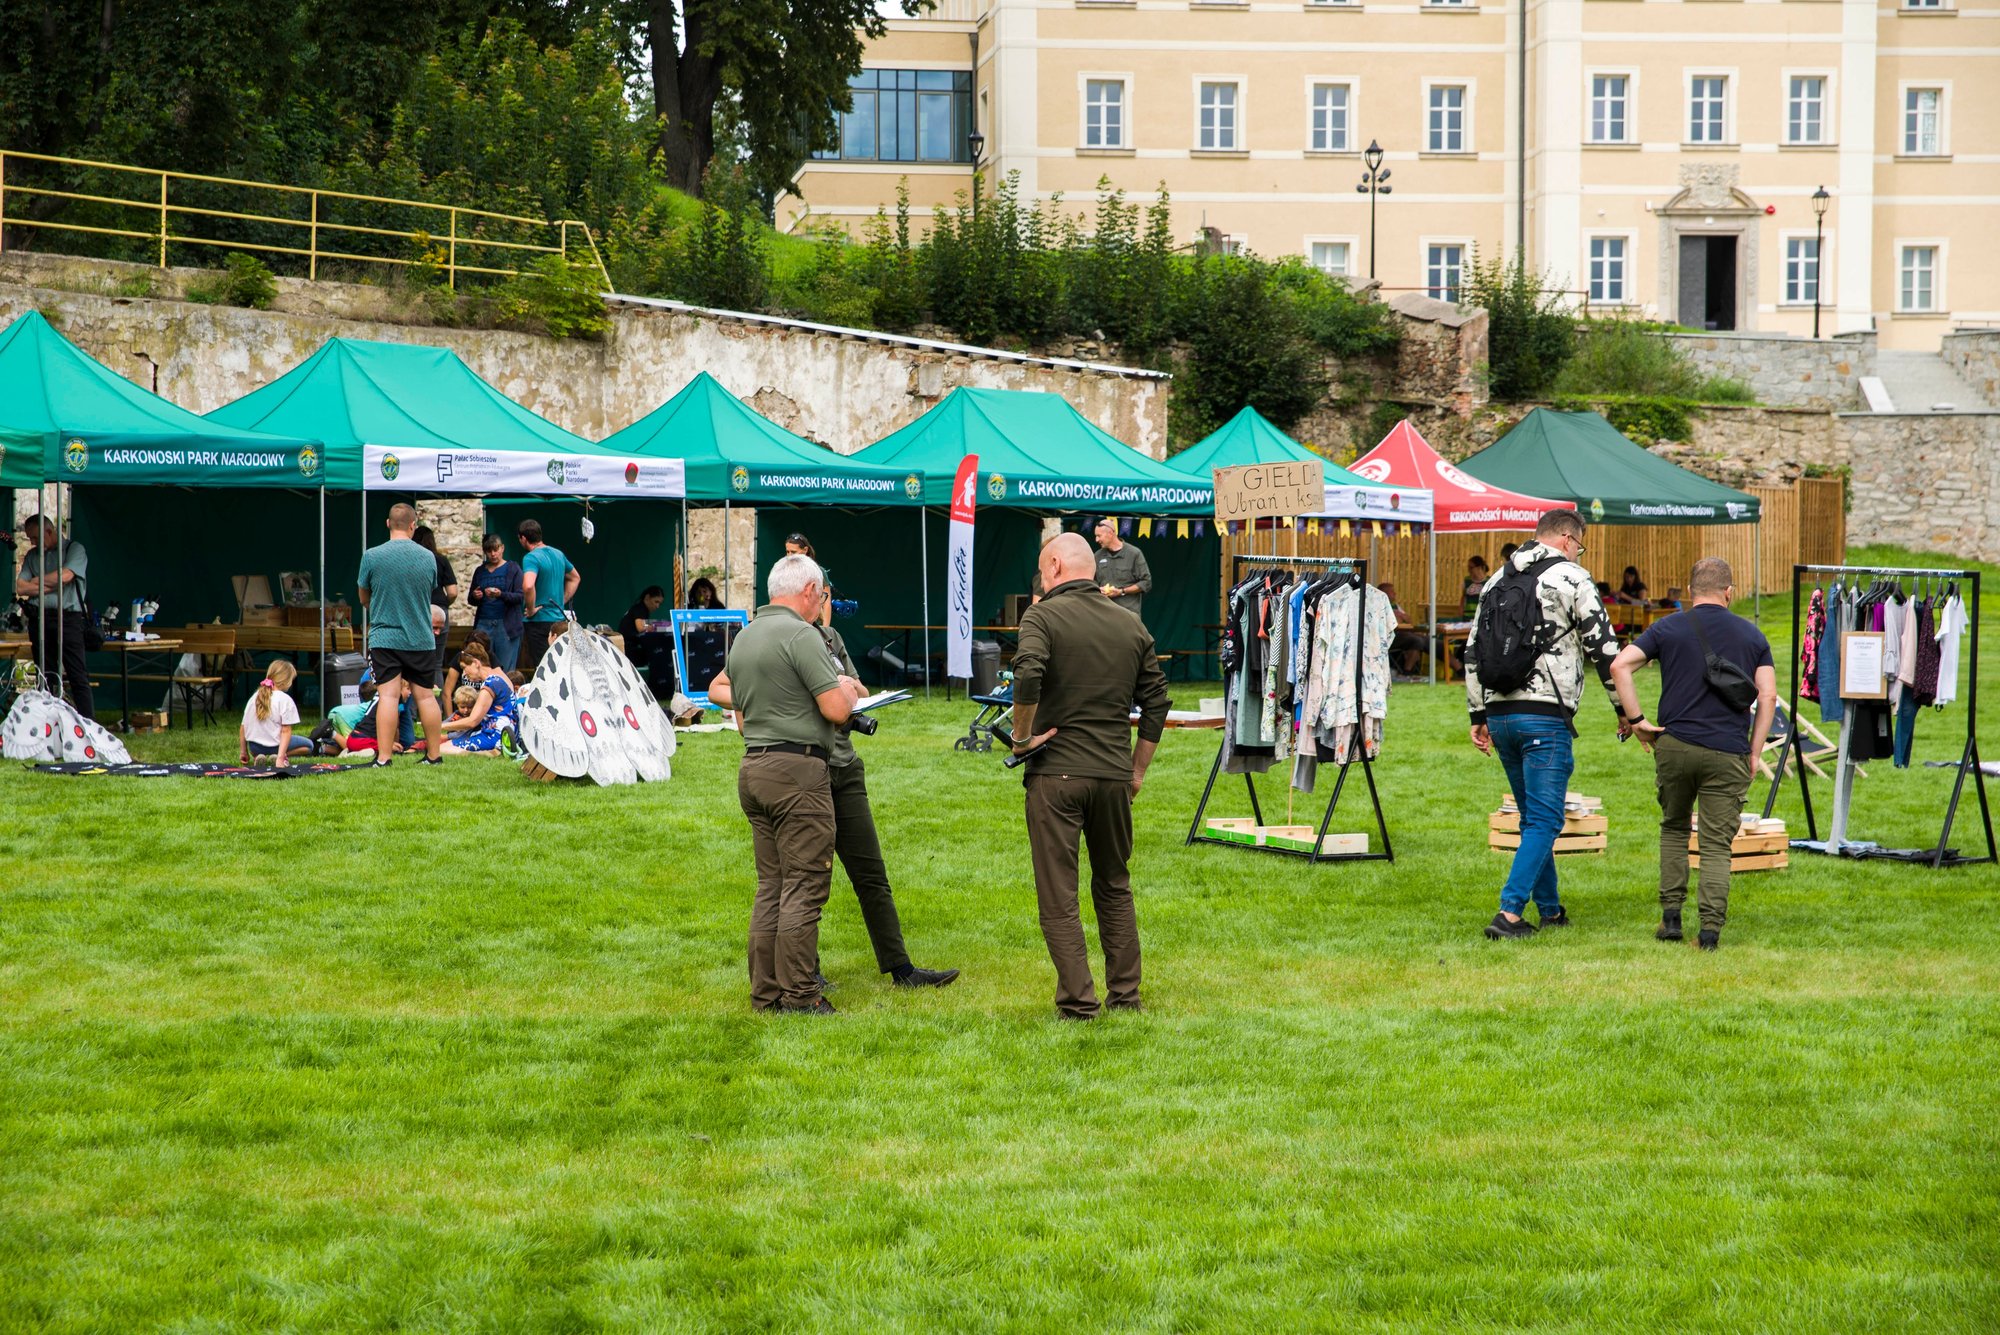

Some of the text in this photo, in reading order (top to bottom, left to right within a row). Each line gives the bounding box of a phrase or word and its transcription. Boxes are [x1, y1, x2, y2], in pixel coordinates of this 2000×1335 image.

[104, 449, 285, 467] KARKONOSKI PARK NARODOWY
[760, 475, 895, 491] KARKONOSKI PARK NARODOWY
[1018, 480, 1212, 504] KARKONOSKI PARK NARODOWY
[1224, 491, 1278, 514] Ubrań
[1450, 507, 1501, 522] KRKONOŠSKÝ
[1502, 507, 1539, 522] NÁRODNÍ
